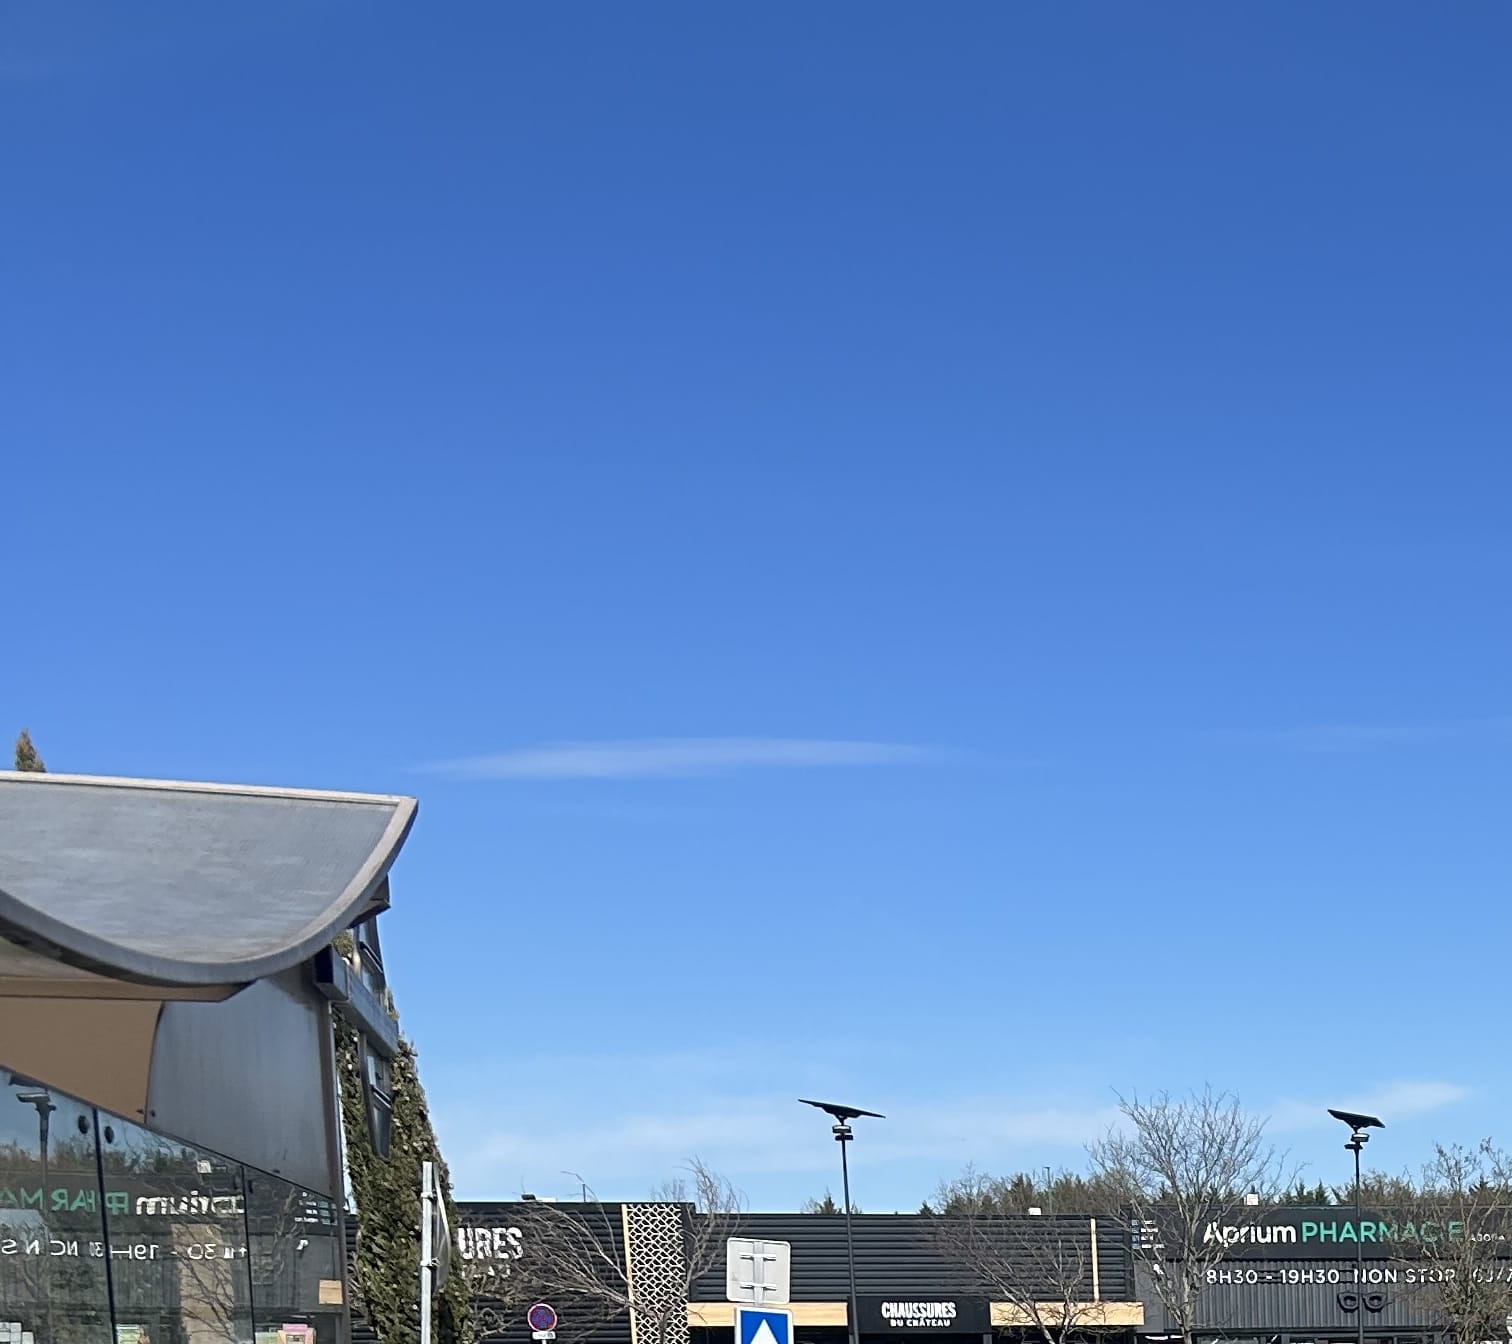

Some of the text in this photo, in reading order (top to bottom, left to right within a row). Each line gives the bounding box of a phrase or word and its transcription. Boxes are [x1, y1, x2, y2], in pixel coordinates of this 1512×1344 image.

[1203, 1221, 1297, 1248] Aprium
[1301, 1221, 1465, 1243] PHARMACE
[1206, 1269, 1258, 1284] 8H30
[1280, 1269, 1340, 1284] 19H30
[1353, 1268, 1397, 1284] NON
[1405, 1268, 1455, 1284] STOP
[881, 1302, 957, 1319] CHAUSSURES
[890, 1319, 904, 1327] DU
